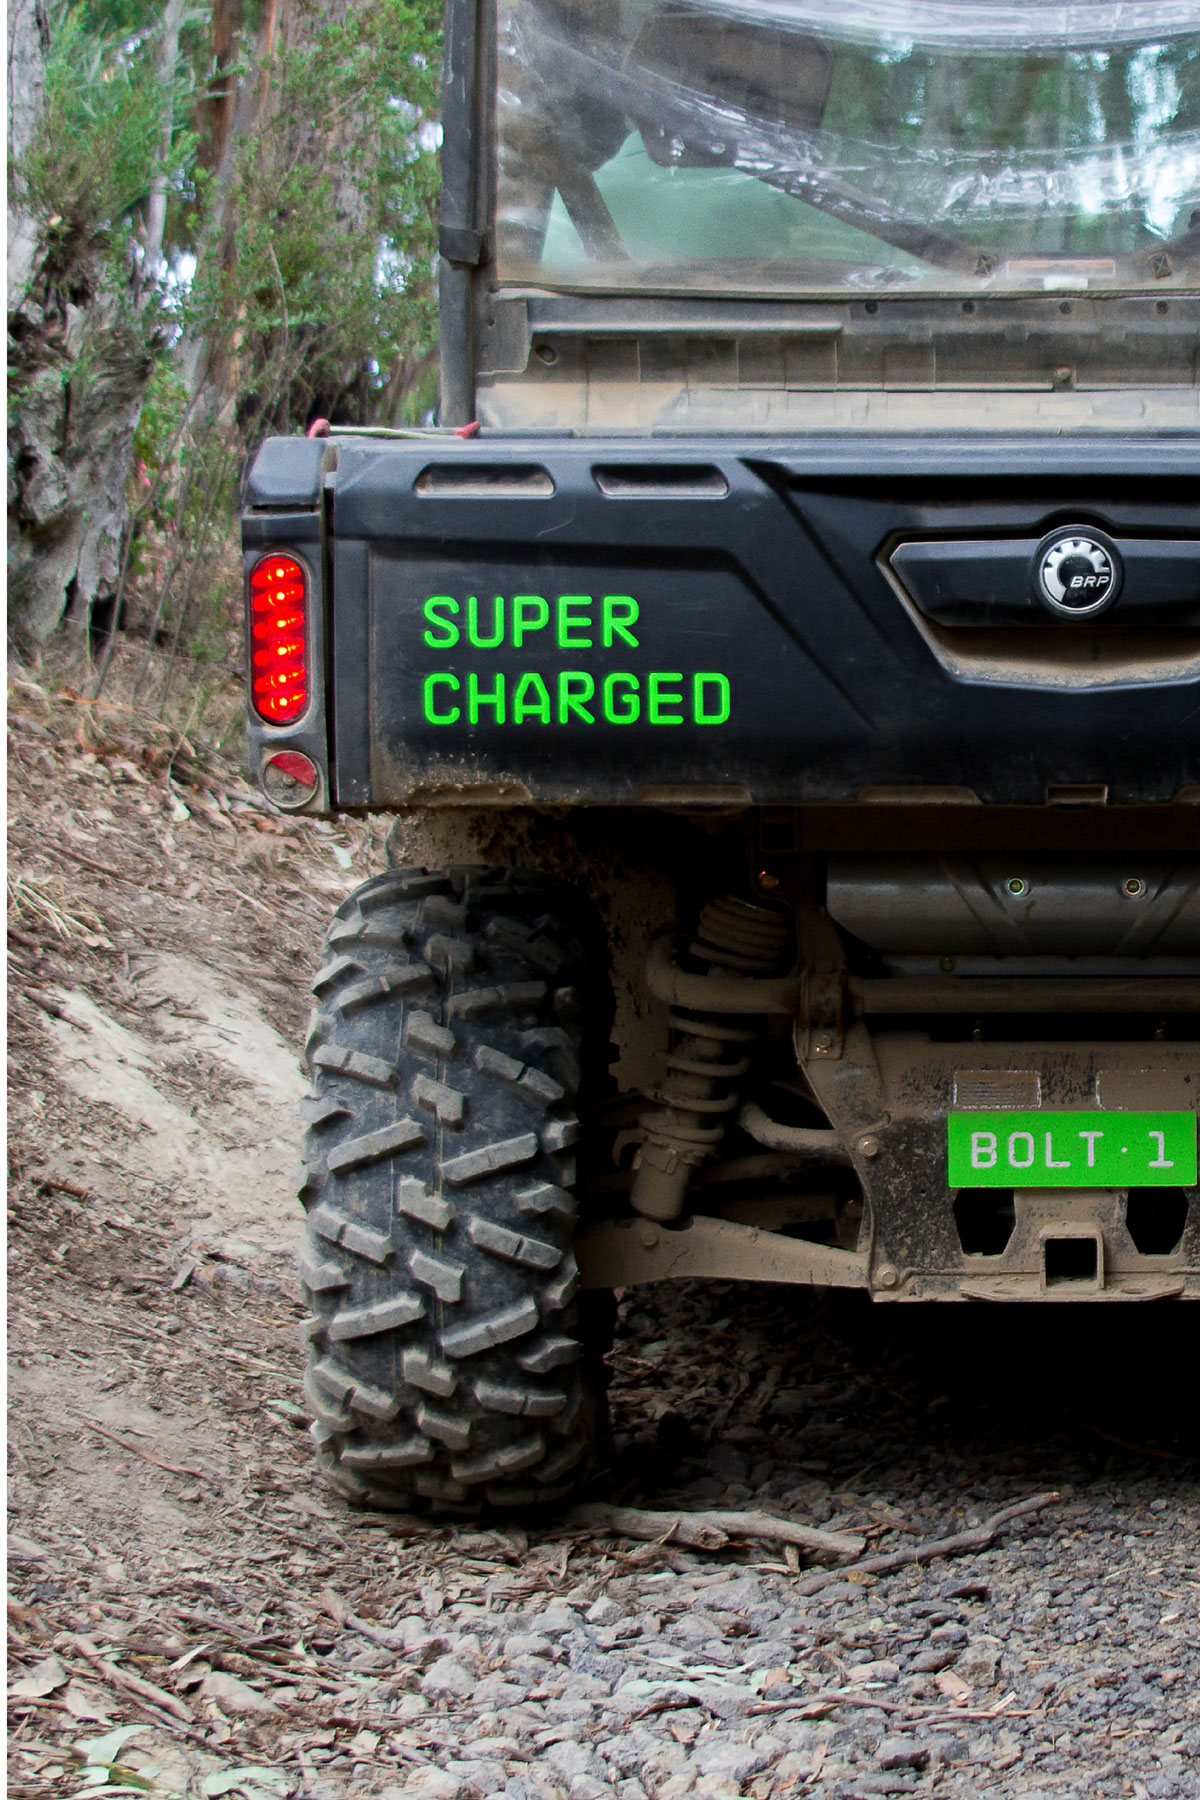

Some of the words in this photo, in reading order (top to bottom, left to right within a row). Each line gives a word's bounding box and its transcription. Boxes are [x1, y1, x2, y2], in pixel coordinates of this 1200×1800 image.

[1070, 575, 1110, 588] BRP
[423, 596, 640, 648] SUPER
[423, 671, 731, 725] CHARGED
